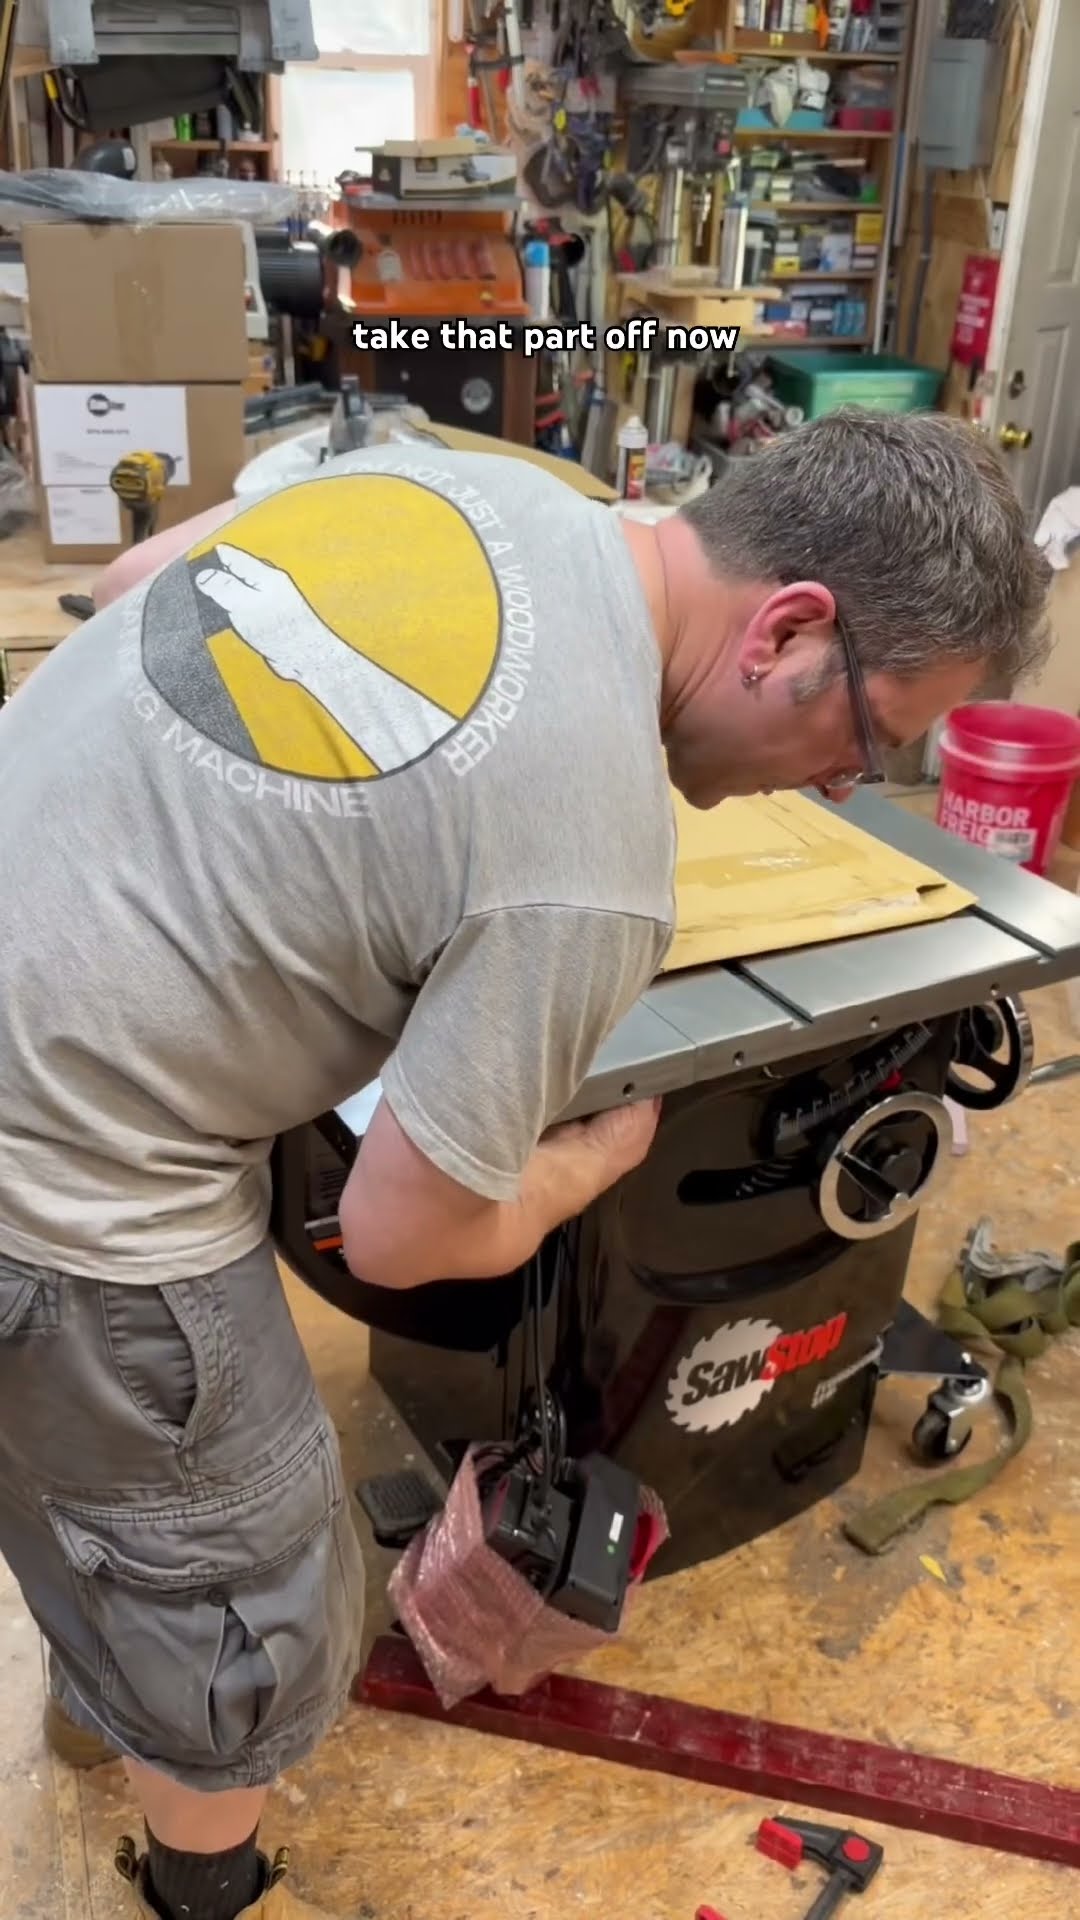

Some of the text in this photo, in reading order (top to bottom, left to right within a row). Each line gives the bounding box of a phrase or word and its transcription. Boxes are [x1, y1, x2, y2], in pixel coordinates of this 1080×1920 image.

[447, 484, 506, 530] JUST
[485, 541, 514, 556] A
[440, 564, 536, 777] WOODWORKER
[162, 719, 371, 817] MACHINE
[940, 791, 1032, 847] HARBOR FREIG
